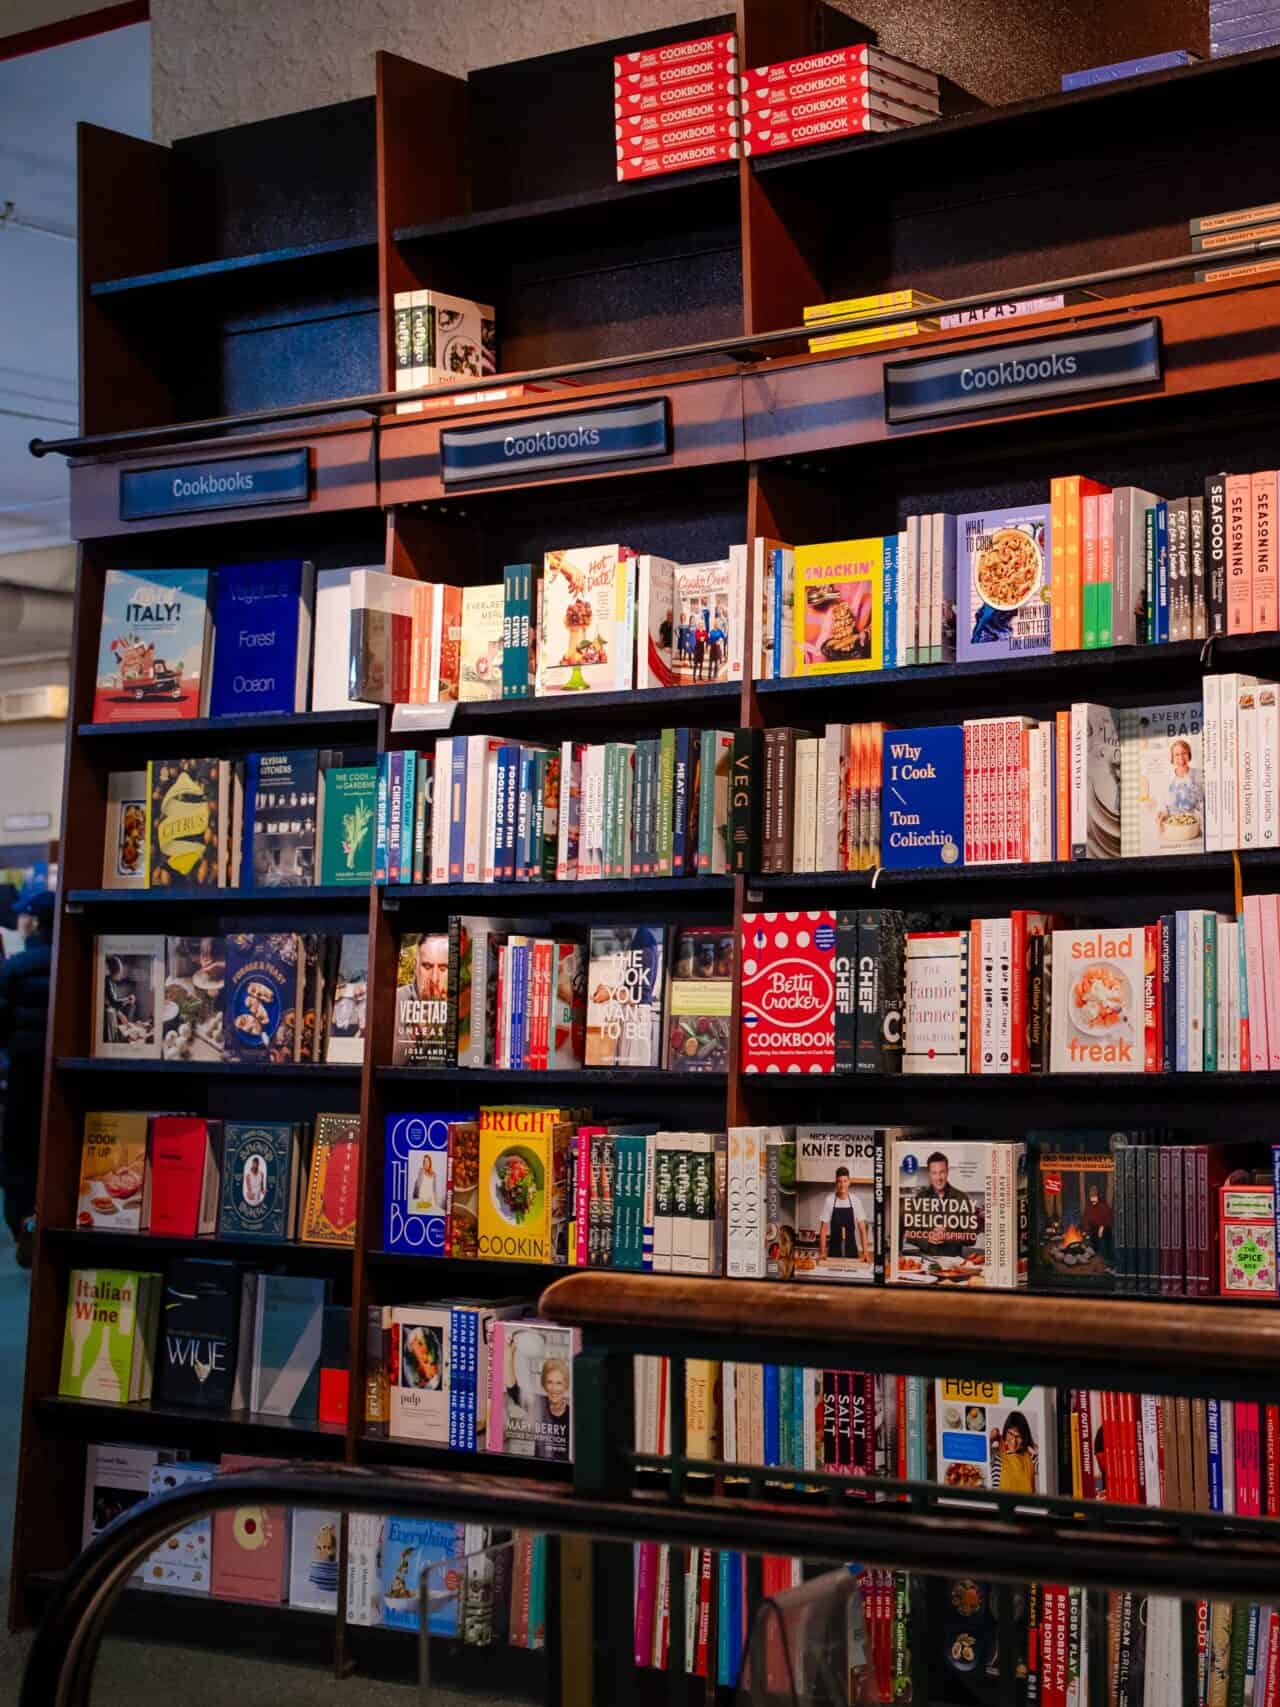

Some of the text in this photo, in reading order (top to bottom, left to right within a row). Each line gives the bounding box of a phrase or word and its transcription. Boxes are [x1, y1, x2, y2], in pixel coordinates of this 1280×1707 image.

[660, 40, 714, 60] COOKBOOK
[660, 61, 714, 81] COOKBOOK
[789, 52, 846, 74] COOKBOOK
[660, 82, 714, 102] COOKBOOK
[790, 74, 846, 95] COOKBOOK
[660, 104, 714, 123] COOKBOOK
[791, 95, 847, 116] COOKBOOK
[662, 124, 716, 144] COOKBOOK
[792, 116, 848, 138] COOKBOOK
[662, 146, 716, 165] COOKBOOK
[960, 353, 1077, 391] Cookbooks
[504, 427, 600, 457] Cookbooks
[173, 472, 254, 497] Cookbooks
[966, 519, 984, 535] WHAT
[1210, 485, 1224, 561] SEAFOOD
[1231, 496, 1243, 577] SEASONING
[1257, 493, 1269, 574] SEASONING
[966, 536, 994, 552] TO COOK
[589, 556, 610, 572] Hot
[805, 560, 874, 579] SNACKIN'
[126, 603, 182, 622] ITALY!
[239, 630, 275, 646] Forest
[233, 676, 275, 693] Ocean
[1152, 712, 1187, 722] EVERY
[891, 745, 922, 761] Why
[734, 756, 749, 807] VEG
[891, 765, 936, 780] I Cook
[161, 814, 205, 837] CITRUS
[890, 812, 920, 825] Tom
[890, 832, 953, 847] Colicchio
[1071, 934, 1133, 959] salad
[768, 972, 814, 994] Betty
[837, 956, 850, 1014] CHEF
[860, 956, 873, 1014] CHEF
[909, 980, 956, 999] Fannie
[607, 987, 641, 1004] YOU
[762, 990, 824, 1010] Crocker
[602, 1006, 649, 1021] WANT
[908, 1005, 958, 1023] Farmer
[600, 1022, 648, 1040] TO BE
[748, 1032, 834, 1048] COOKBOOK
[1067, 1039, 1132, 1062] freak
[479, 1110, 559, 1133] BRIGHT
[87, 1134, 117, 1144] COOK
[802, 1143, 875, 1158] KNIFE DRO
[904, 1199, 977, 1213] EVERYDAY
[904, 1214, 978, 1230] DELICIOUS
[1238, 1254, 1263, 1262] SPICE
[75, 1280, 132, 1302] Italian
[75, 1301, 118, 1323] Wine
[459, 1313, 467, 1342] EITAN
[945, 1376, 994, 1398] Here
[400, 1393, 421, 1406] pulp
[459, 1390, 467, 1409] THE
[824, 1393, 836, 1435] SALT
[838, 1394, 851, 1437] SALT
[852, 1395, 866, 1439] SALT
[459, 1412, 467, 1448] WORLD
[535, 1422, 567, 1436] BERRY
[1043, 1593, 1052, 1691] BEAT BOBBY FLAY
[1056, 1594, 1065, 1692] BEAT BOBBY FLAY
[1070, 1597, 1080, 1674] BOBBY FLAY
